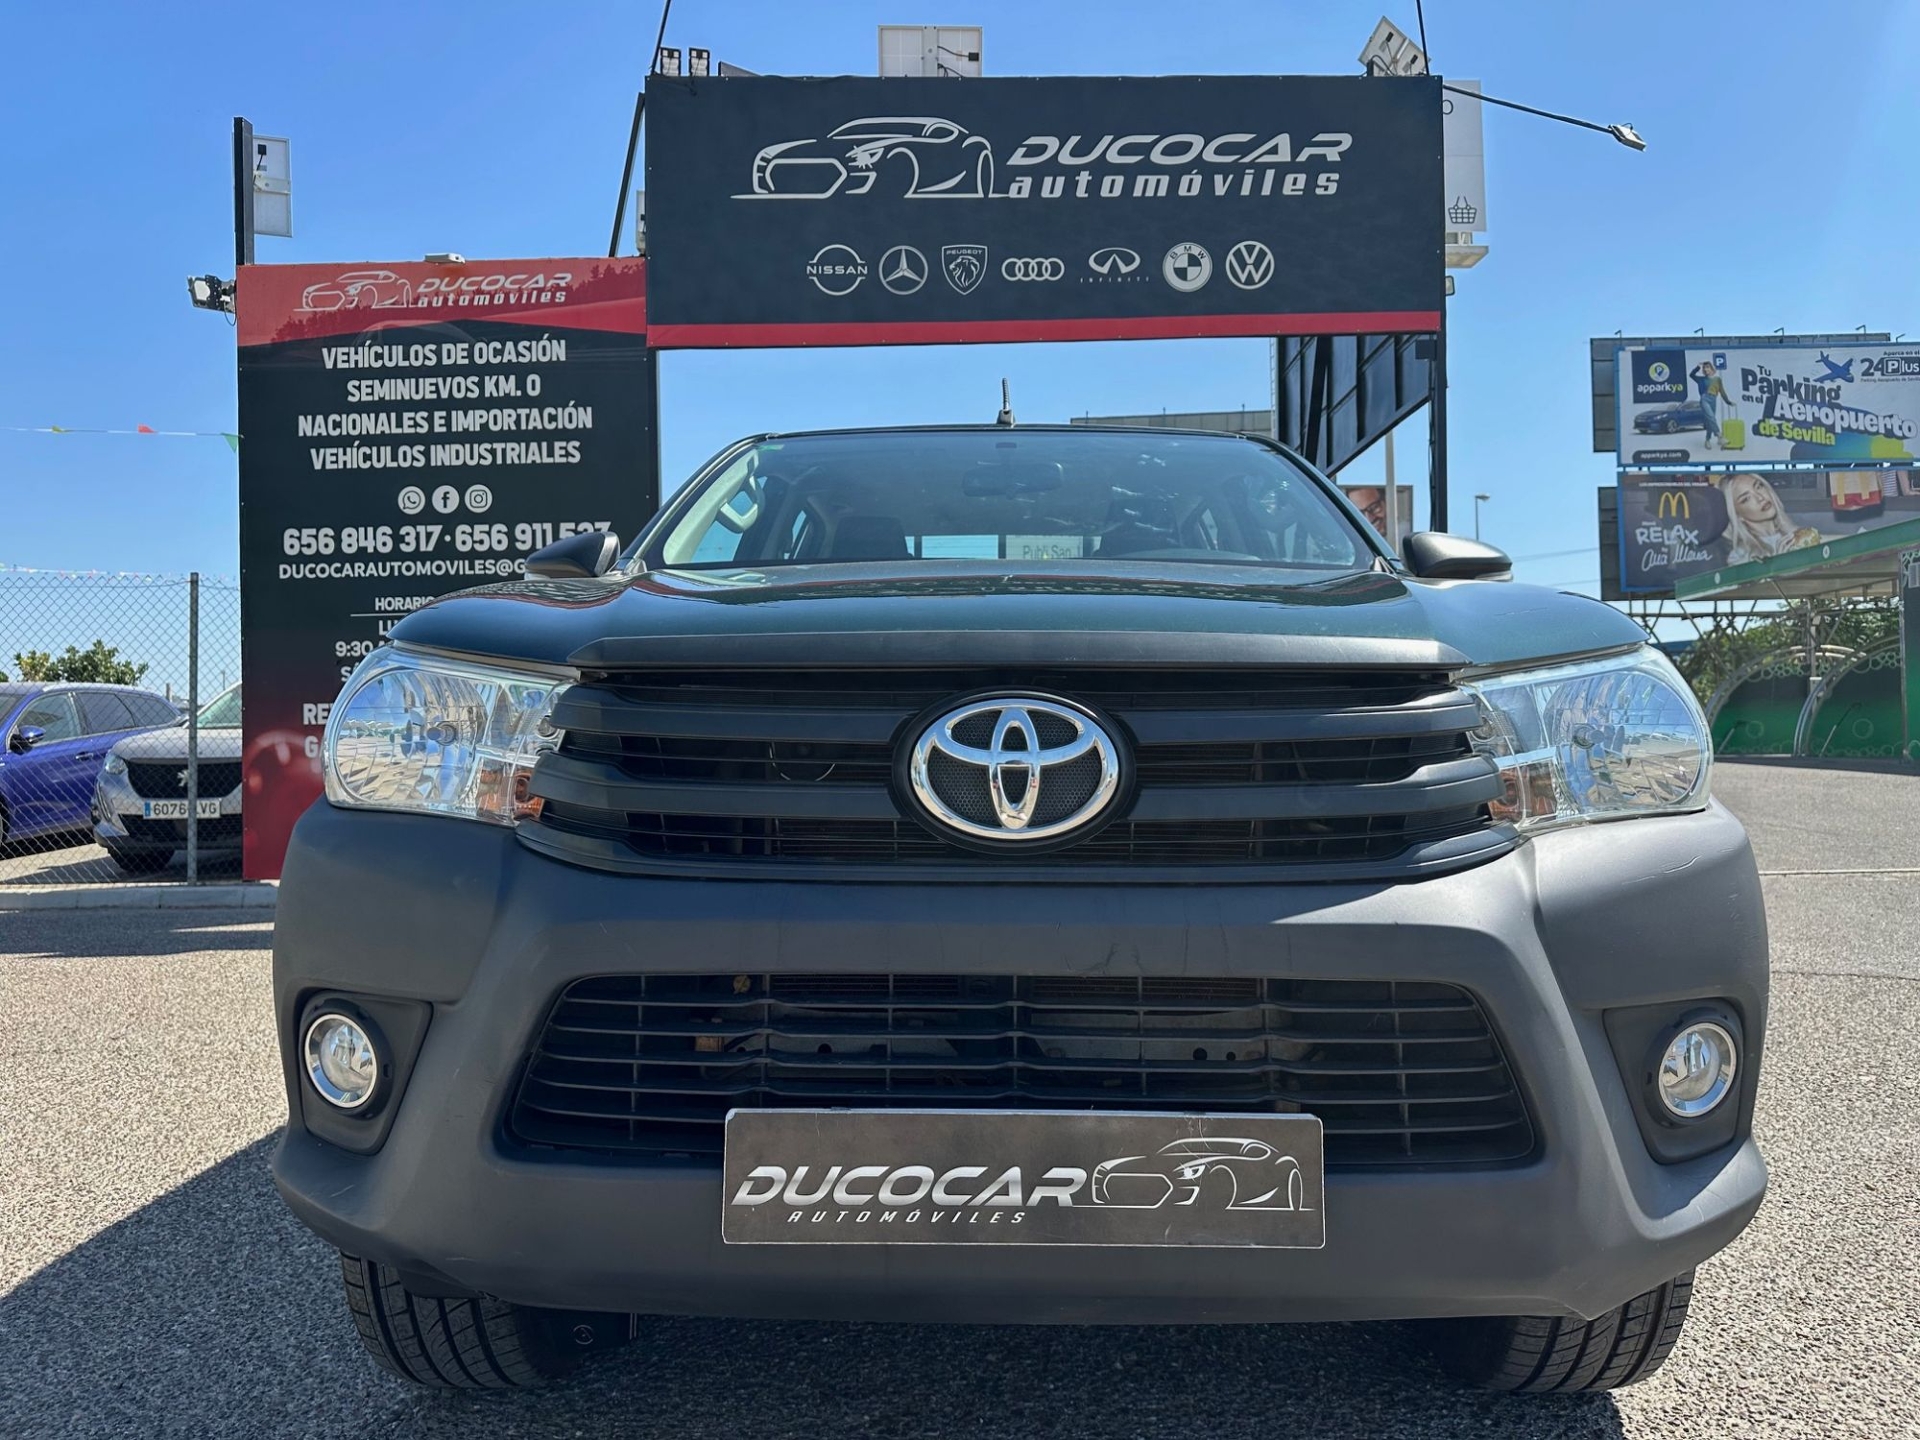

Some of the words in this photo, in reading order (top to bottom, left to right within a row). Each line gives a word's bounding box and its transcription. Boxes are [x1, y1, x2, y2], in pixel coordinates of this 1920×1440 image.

[1006, 132, 1353, 166] DUCOCAR
[1009, 169, 1340, 199] automóviles
[1169, 245, 1207, 261] BMW
[806, 265, 868, 275] NISSAN
[417, 272, 573, 293] DUCOCAR
[417, 290, 567, 308] automóviles
[321, 340, 437, 370] VEHÍCULOS
[442, 343, 469, 366] DE
[473, 333, 567, 365] OCASIÓN
[1757, 364, 1771, 377] Tu
[346, 376, 480, 402] SEMINUEVOS
[484, 374, 522, 398] KM.
[1637, 382, 1683, 394] apparkya
[1741, 367, 1842, 410] Parking
[1742, 394, 1754, 403] en
[1755, 395, 1764, 404] el
[298, 411, 429, 437] NACIONALES
[433, 408, 447, 433] E
[451, 400, 593, 432] IMPORTACIÓN
[1773, 393, 1918, 438] Aeropuerto
[1759, 418, 1779, 436] de
[1781, 421, 1836, 446] Sevilla
[310, 440, 426, 470] VEHÍCULOS
[430, 440, 582, 467] INDUSTRIALES
[283, 528, 335, 556] 656
[340, 526, 393, 553] 846
[399, 525, 443, 552] 317
[454, 523, 509, 552] 656
[514, 522, 553, 551] 911
[1635, 524, 1699, 545] RELAX
[278, 559, 526, 580] DUCOCARAUTOMOVILES@G
[335, 640, 374, 657] 9:30
[153, 802, 187, 816] 6076
[196, 802, 217, 816] VG
[731, 1165, 1087, 1207] DUCOCAR
[787, 1208, 1026, 1224] AUTOMÓVILES
